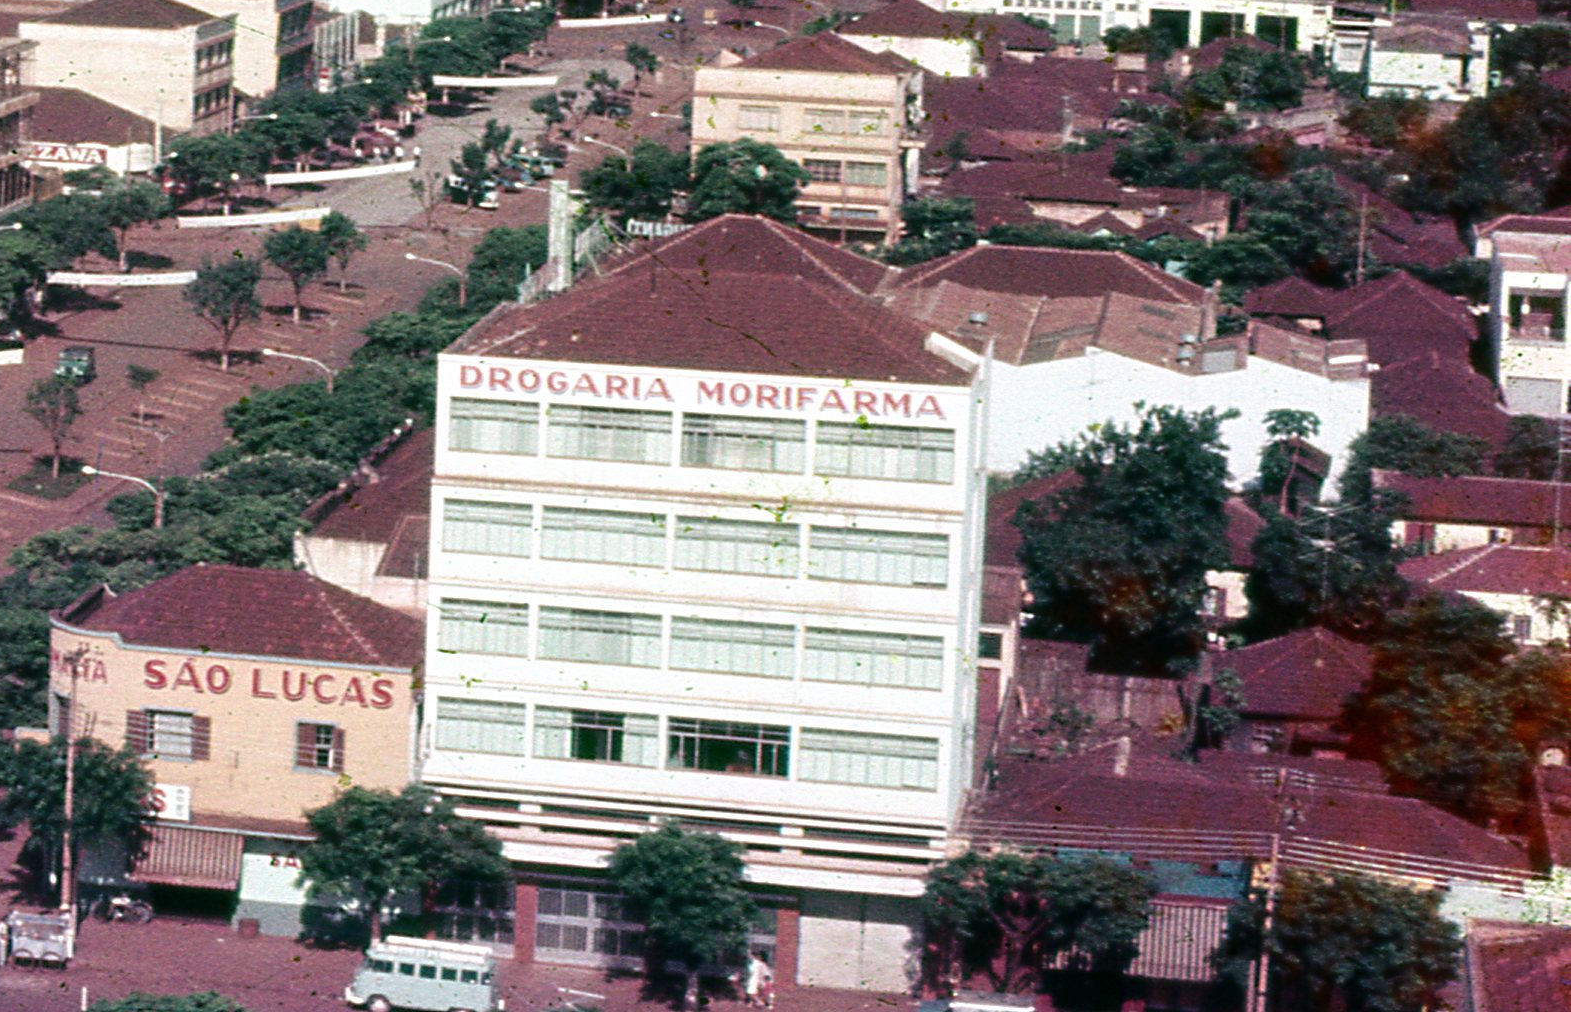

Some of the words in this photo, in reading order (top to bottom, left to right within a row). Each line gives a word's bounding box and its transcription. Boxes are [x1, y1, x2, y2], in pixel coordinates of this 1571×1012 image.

[460, 365, 675, 403] DROGARIA
[696, 380, 947, 420] MORIFARMA
[144, 658, 232, 694] SÃO
[251, 668, 395, 709] LUCAS
